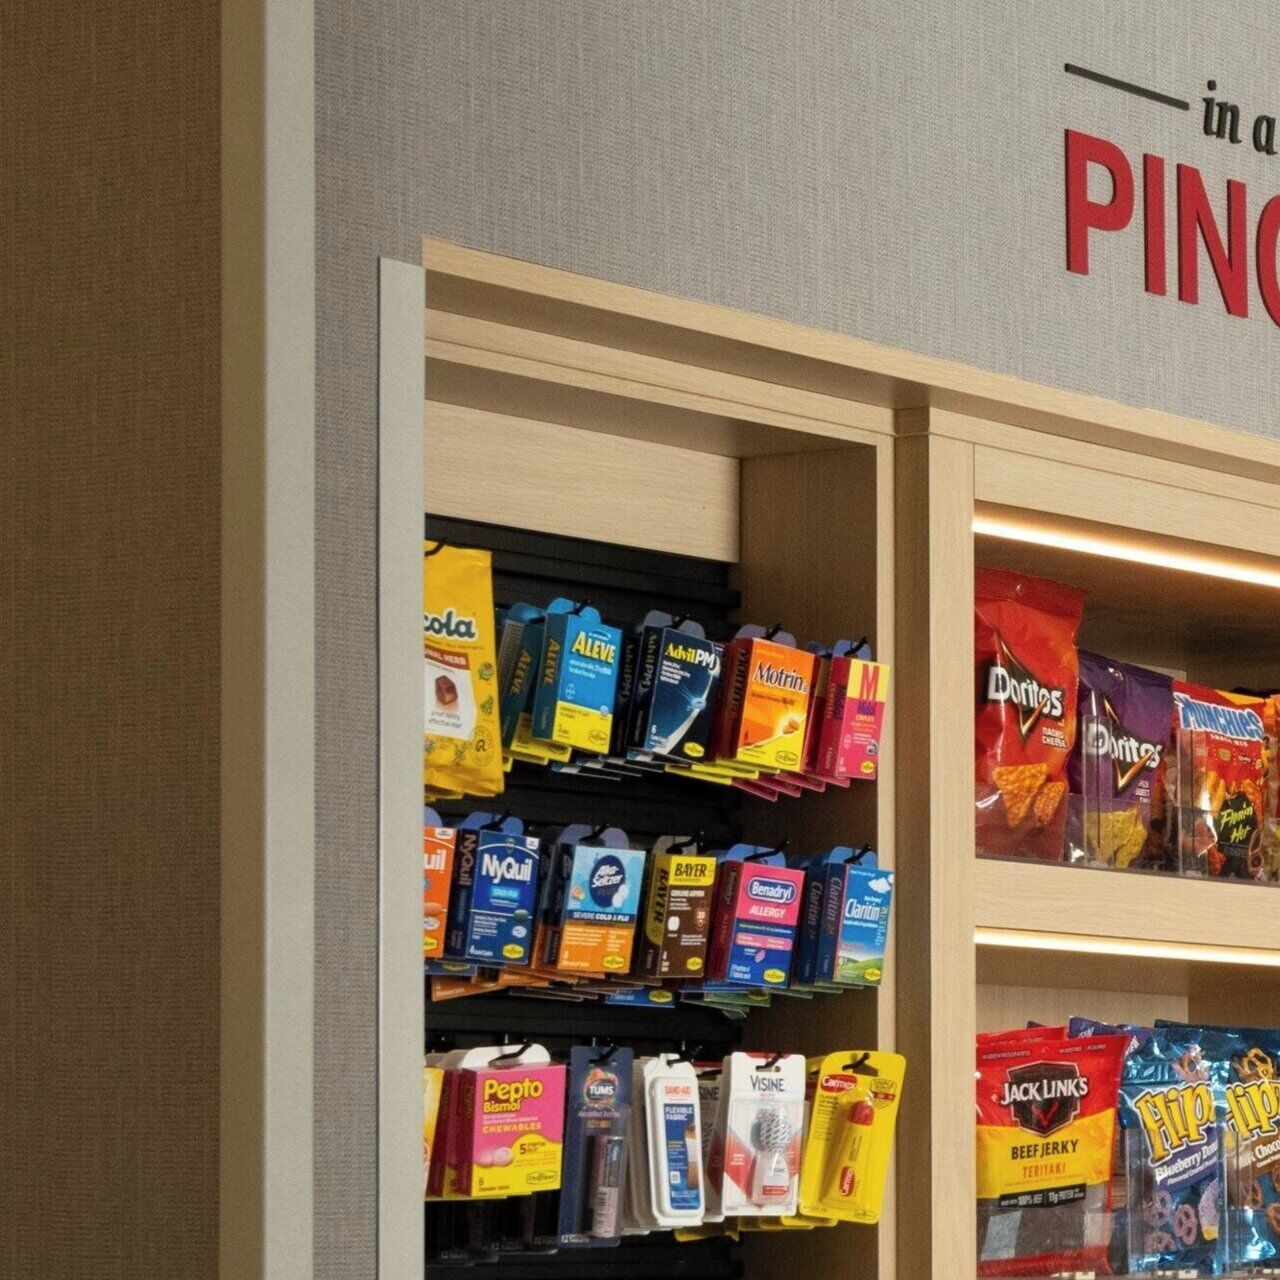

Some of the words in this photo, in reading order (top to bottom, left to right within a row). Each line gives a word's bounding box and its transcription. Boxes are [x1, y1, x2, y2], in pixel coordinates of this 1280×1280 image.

[1202, 80, 1242, 143] in
[1253, 114, 1278, 155] a
[572, 631, 616, 664] ALEVE
[754, 661, 804, 691] Motrin
[990, 665, 1064, 717] Doritos
[1042, 735, 1067, 748] CHEESE
[1088, 722, 1163, 769] Doritos
[482, 853, 533, 884] NyQuil
[674, 862, 707, 877] BAYER
[591, 875, 623, 888] Seltzer
[750, 881, 793, 901] Benadryl
[573, 911, 595, 920] SEVERE
[595, 913, 612, 921] COLD
[617, 914, 630, 922] FLU
[749, 905, 786, 918] ALLERGY
[845, 899, 880, 921] Claritin
[483, 1078, 544, 1102] Pepto
[589, 1084, 614, 1095] TUMS
[664, 1085, 691, 1095] BAND-AID
[750, 1075, 786, 1092] VISINE
[821, 1075, 857, 1091] Carmex
[1000, 1083, 1040, 1105] JACK
[1042, 1076, 1089, 1100] LINK'S
[483, 1100, 521, 1113] Bismol
[665, 1106, 693, 1114] FLEXIBLE
[665, 1113, 688, 1121] FABRIC
[482, 1122, 542, 1135] CHEWABLES
[1010, 1142, 1039, 1160] BEEF
[1039, 1139, 1079, 1158] JERKY
[1022, 1161, 1066, 1179] TERIYAKI
[1155, 1150, 1200, 1185] Blueberry
